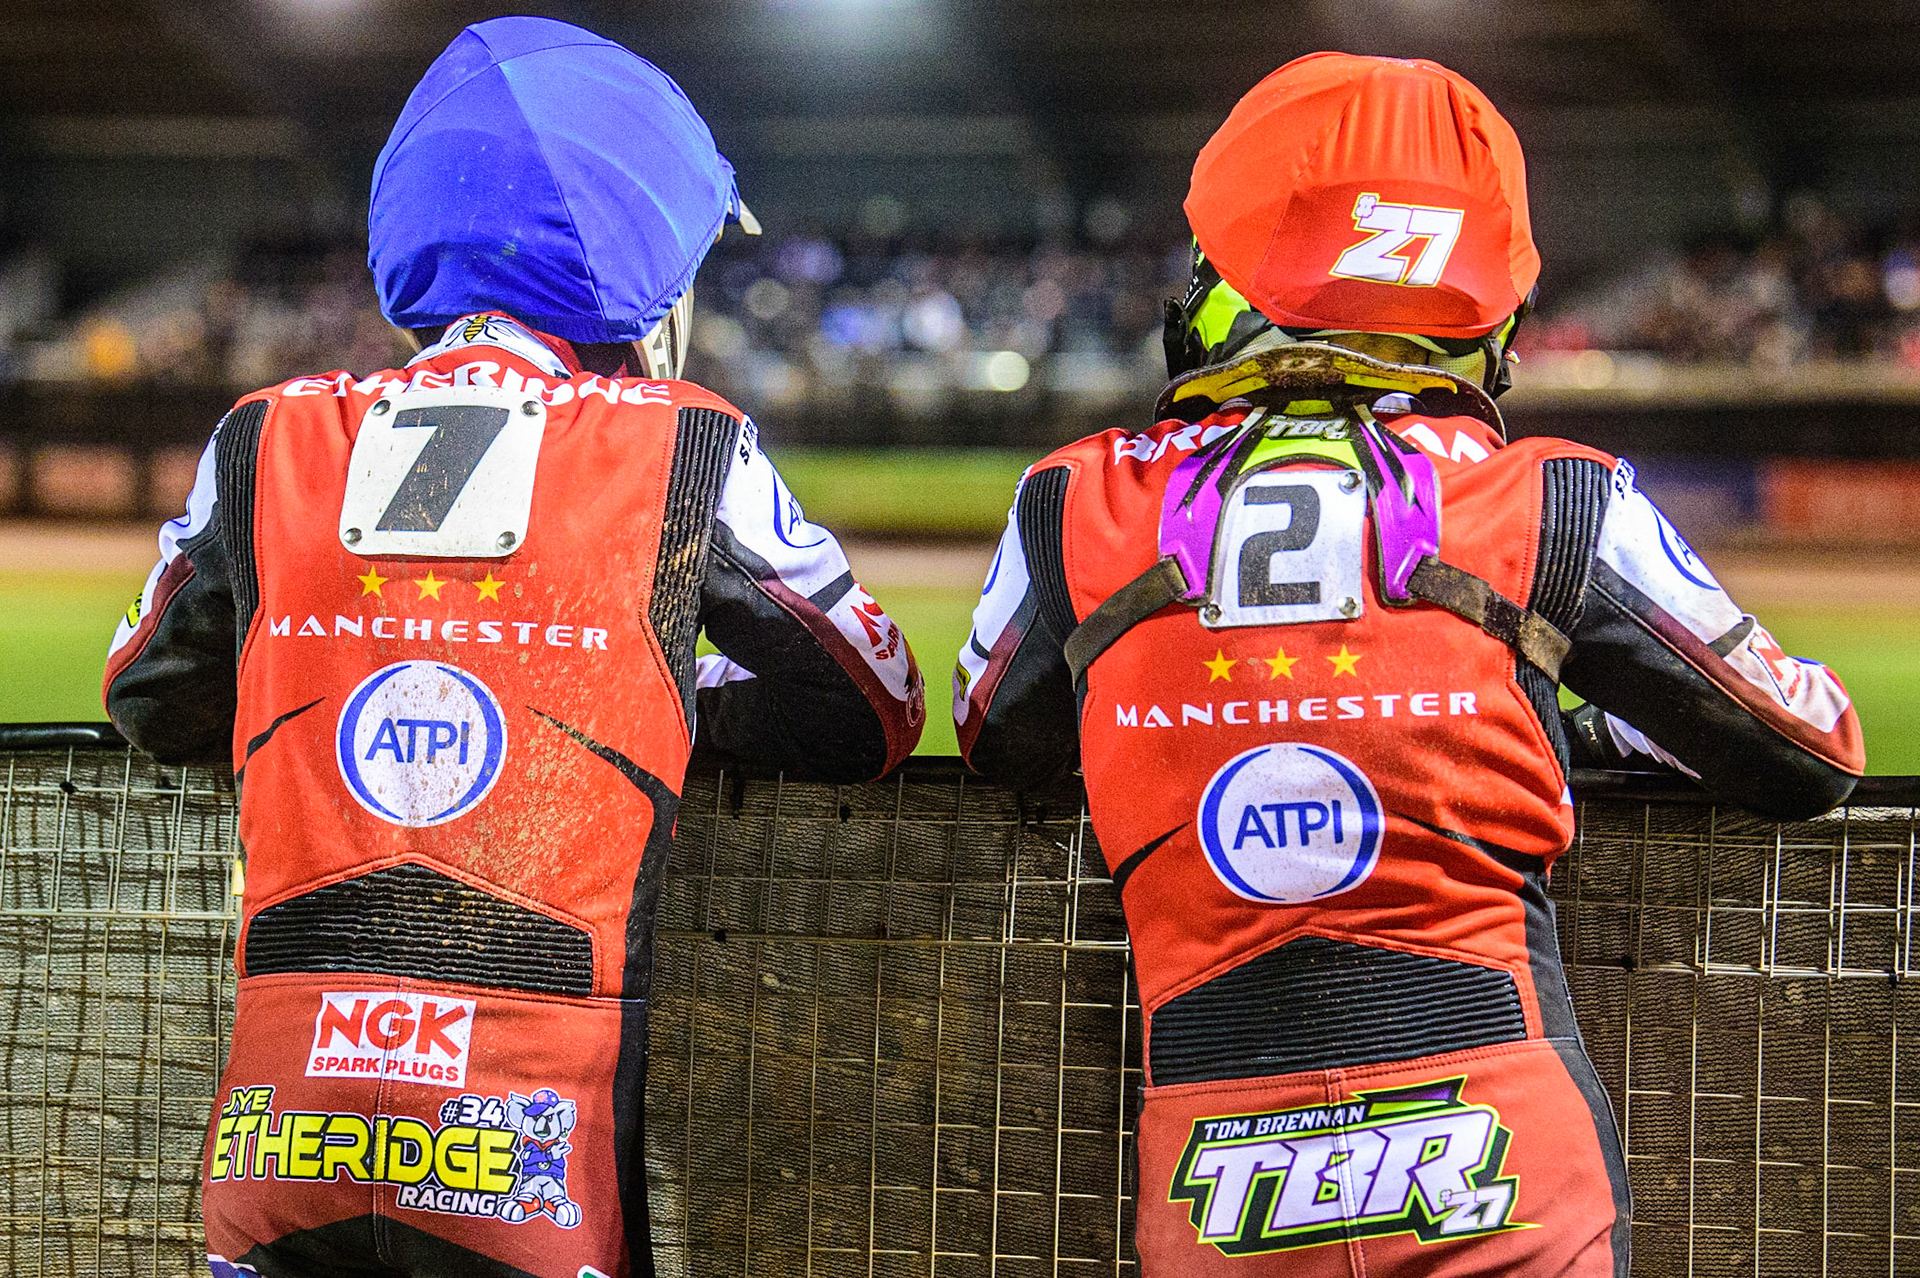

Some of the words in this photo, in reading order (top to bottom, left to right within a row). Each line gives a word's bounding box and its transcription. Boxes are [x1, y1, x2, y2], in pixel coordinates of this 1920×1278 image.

[376, 405, 510, 532] 7
[1238, 484, 1321, 608] 2
[270, 615, 608, 650] MANCHESTER
[1116, 692, 1478, 728] MANCHESTER
[364, 717, 470, 765] ATPI
[1233, 799, 1344, 851] ATPI
[317, 999, 469, 1059] NGK
[312, 1055, 378, 1074] SPARK
[385, 1060, 459, 1082] PLUGS
[224, 1089, 270, 1113] JYE
[443, 1099, 503, 1126] #34
[1204, 1119, 1251, 1141] TOM
[1254, 1105, 1366, 1136] BRENNAN
[211, 1113, 517, 1192] ETHERIDGE
[1193, 1110, 1493, 1235] TBR
[400, 1188, 497, 1215] RACING
